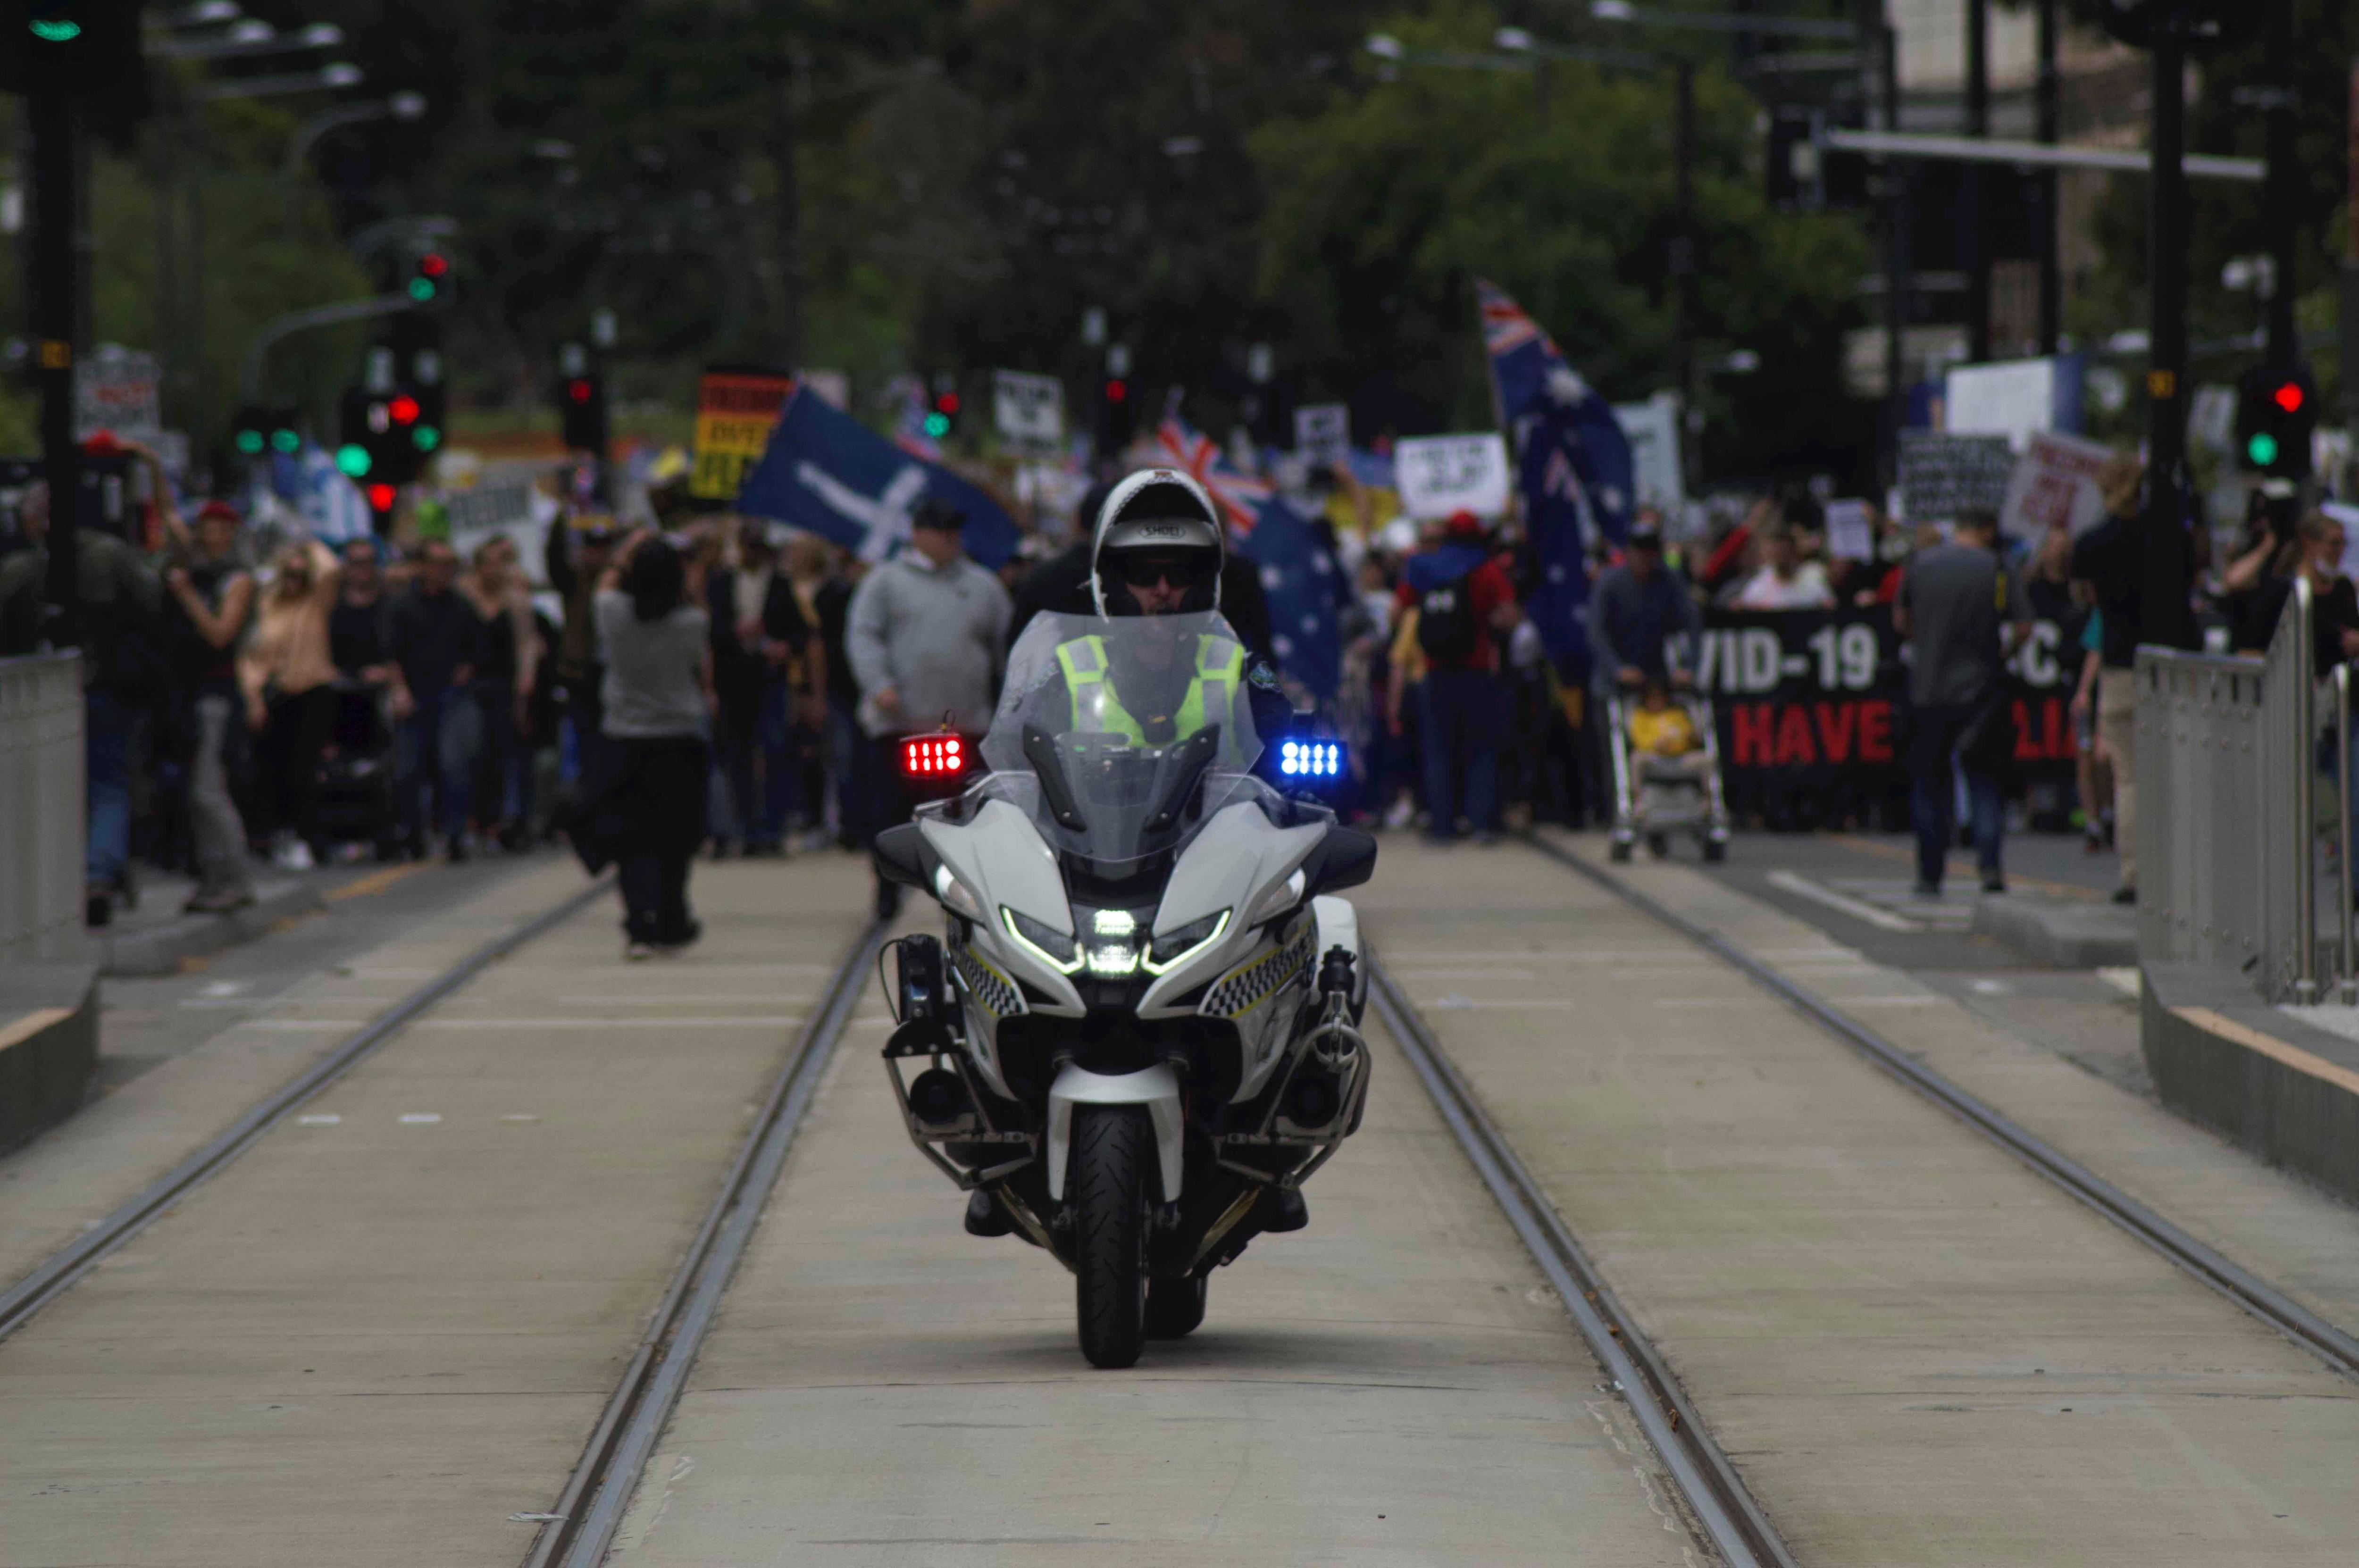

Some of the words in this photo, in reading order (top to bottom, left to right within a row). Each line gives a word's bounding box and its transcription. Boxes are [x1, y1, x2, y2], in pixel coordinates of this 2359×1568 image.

[1145, 525, 1180, 537] SHOEI
[1663, 623, 1879, 692] VID-19
[1732, 700, 1893, 767] HAVE
